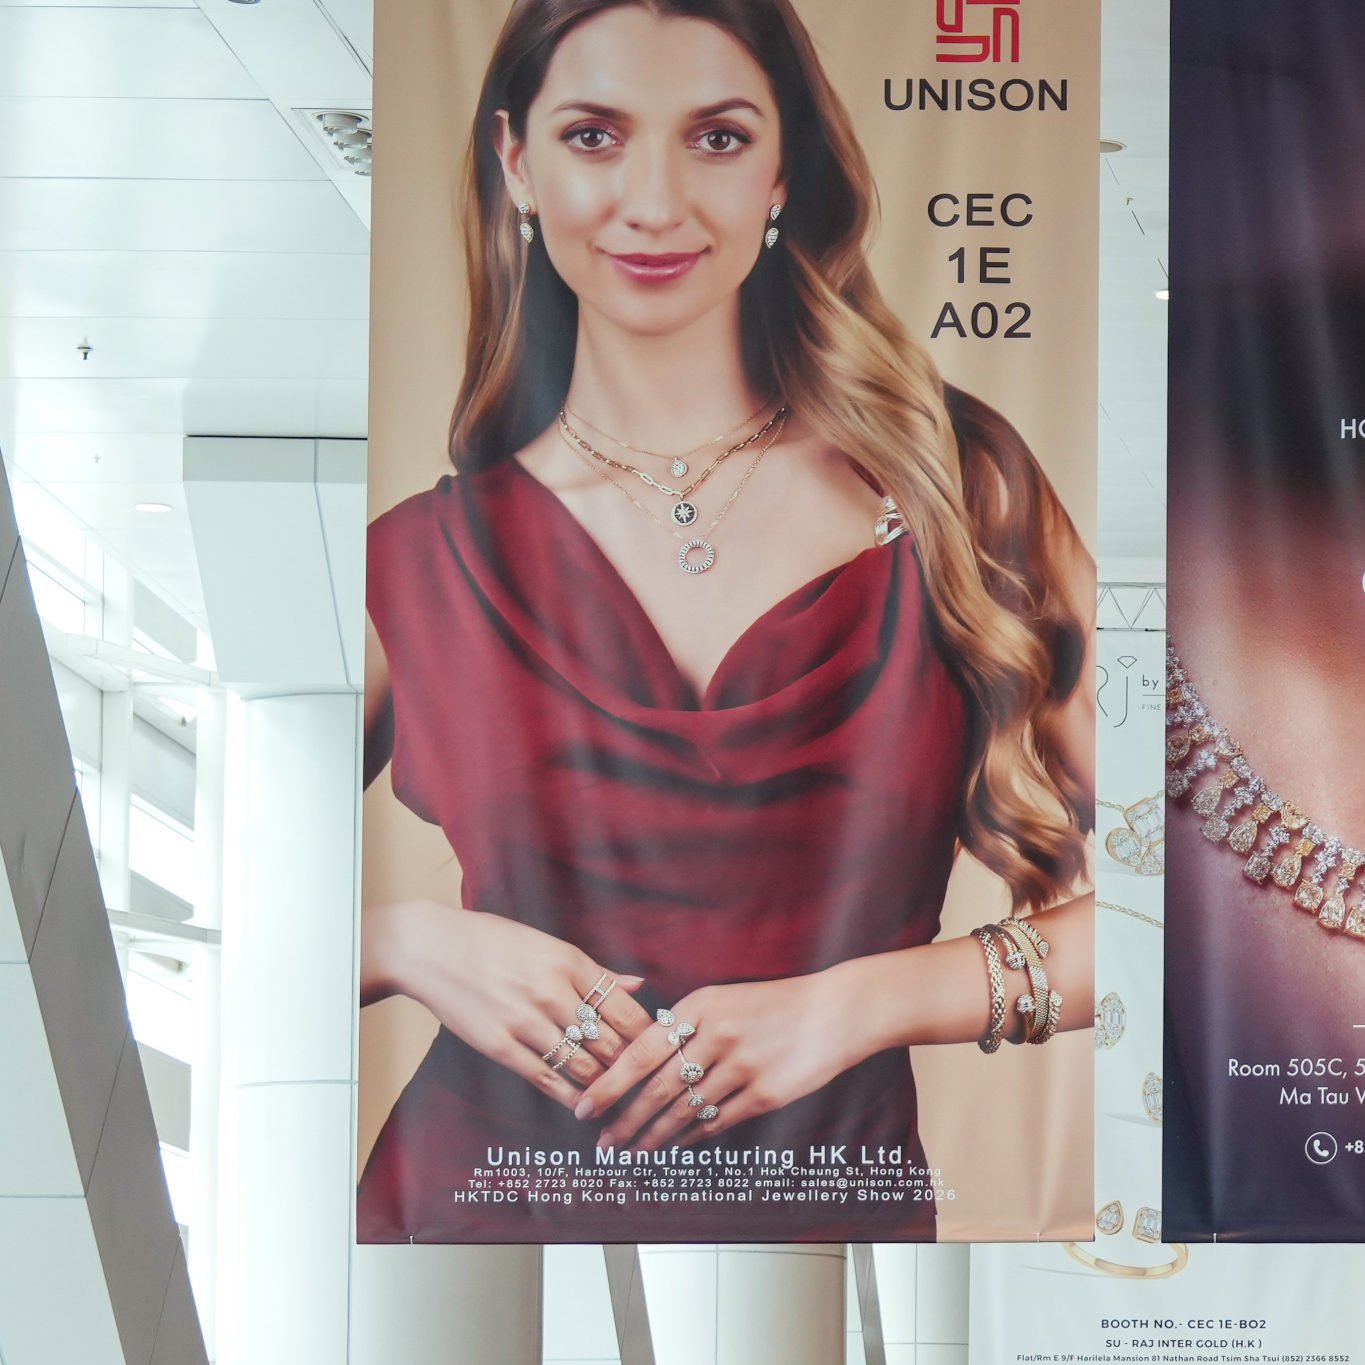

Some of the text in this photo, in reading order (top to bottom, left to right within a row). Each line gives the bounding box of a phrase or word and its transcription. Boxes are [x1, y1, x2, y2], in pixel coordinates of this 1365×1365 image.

[884, 78, 1068, 112] UNISON
[927, 192, 1033, 228] CEC
[948, 246, 1011, 284] 1E
[930, 301, 1032, 339] A02
[1142, 674, 1160, 690] by
[487, 1146, 913, 1169] Unison Manufacturing HK Ltd.
[1101, 1319, 1149, 1329] BOOTH
[1187, 1319, 1214, 1329] CEC
